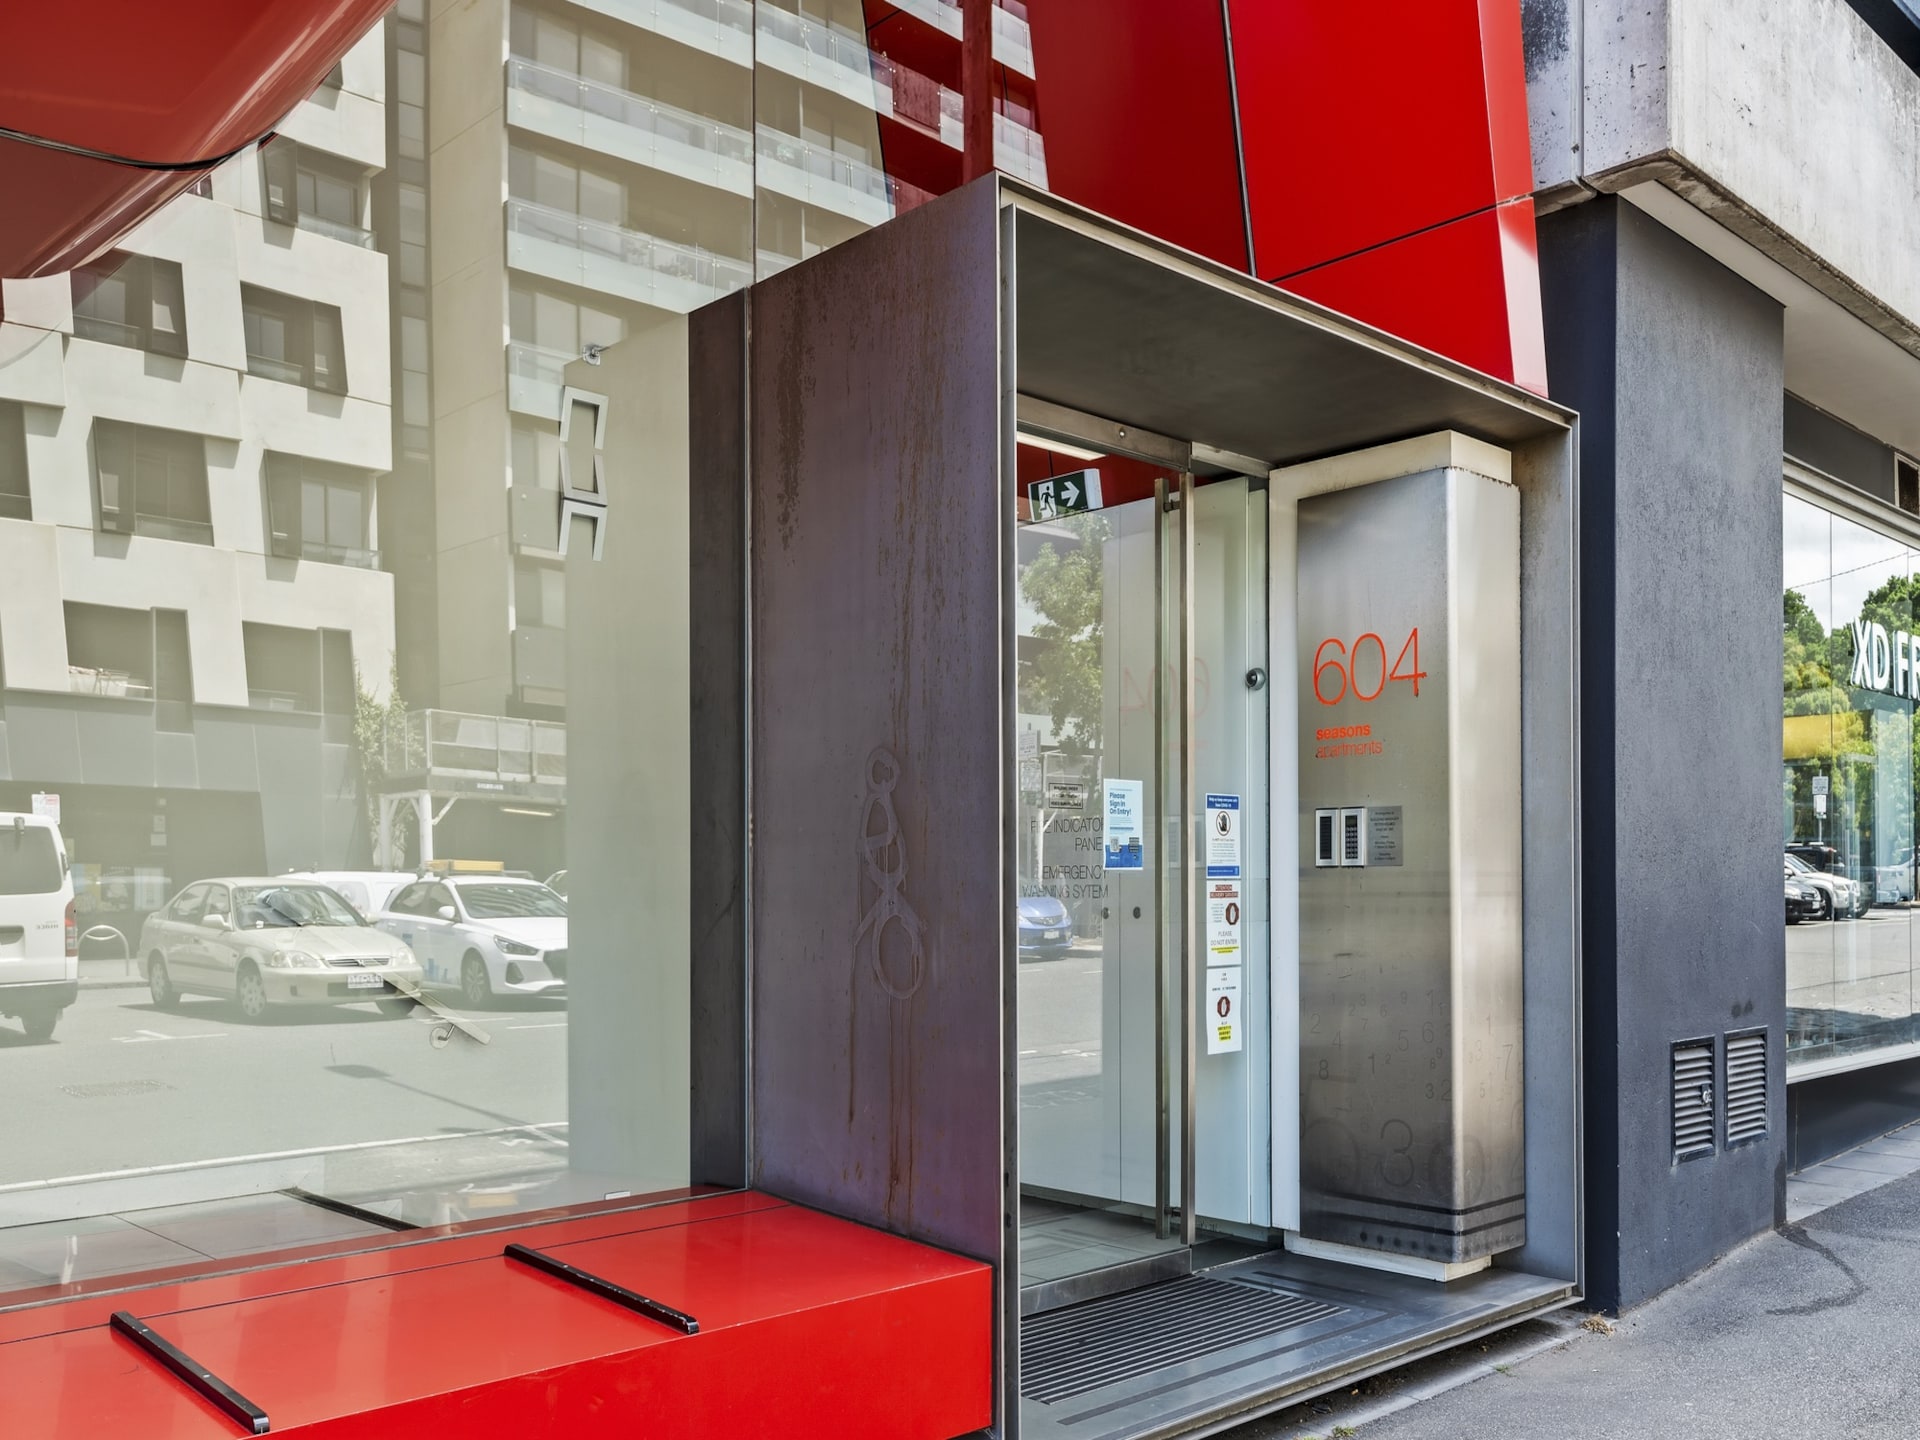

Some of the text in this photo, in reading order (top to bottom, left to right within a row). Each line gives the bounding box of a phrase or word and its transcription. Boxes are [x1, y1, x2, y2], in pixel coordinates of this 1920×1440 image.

[1851, 617, 1890, 690] XD
[1313, 627, 1427, 706] 604
[1316, 724, 1372, 741] seasons
[1315, 740, 1383, 759] apartments
[1030, 820, 1051, 834] FIE
[1075, 837, 1103, 851] PANE
[1043, 864, 1108, 880] EMERGENCY
[1073, 884, 1109, 899] SYTEM
[1319, 1060, 1329, 1080] 8
[1380, 1119, 1414, 1187] 3
